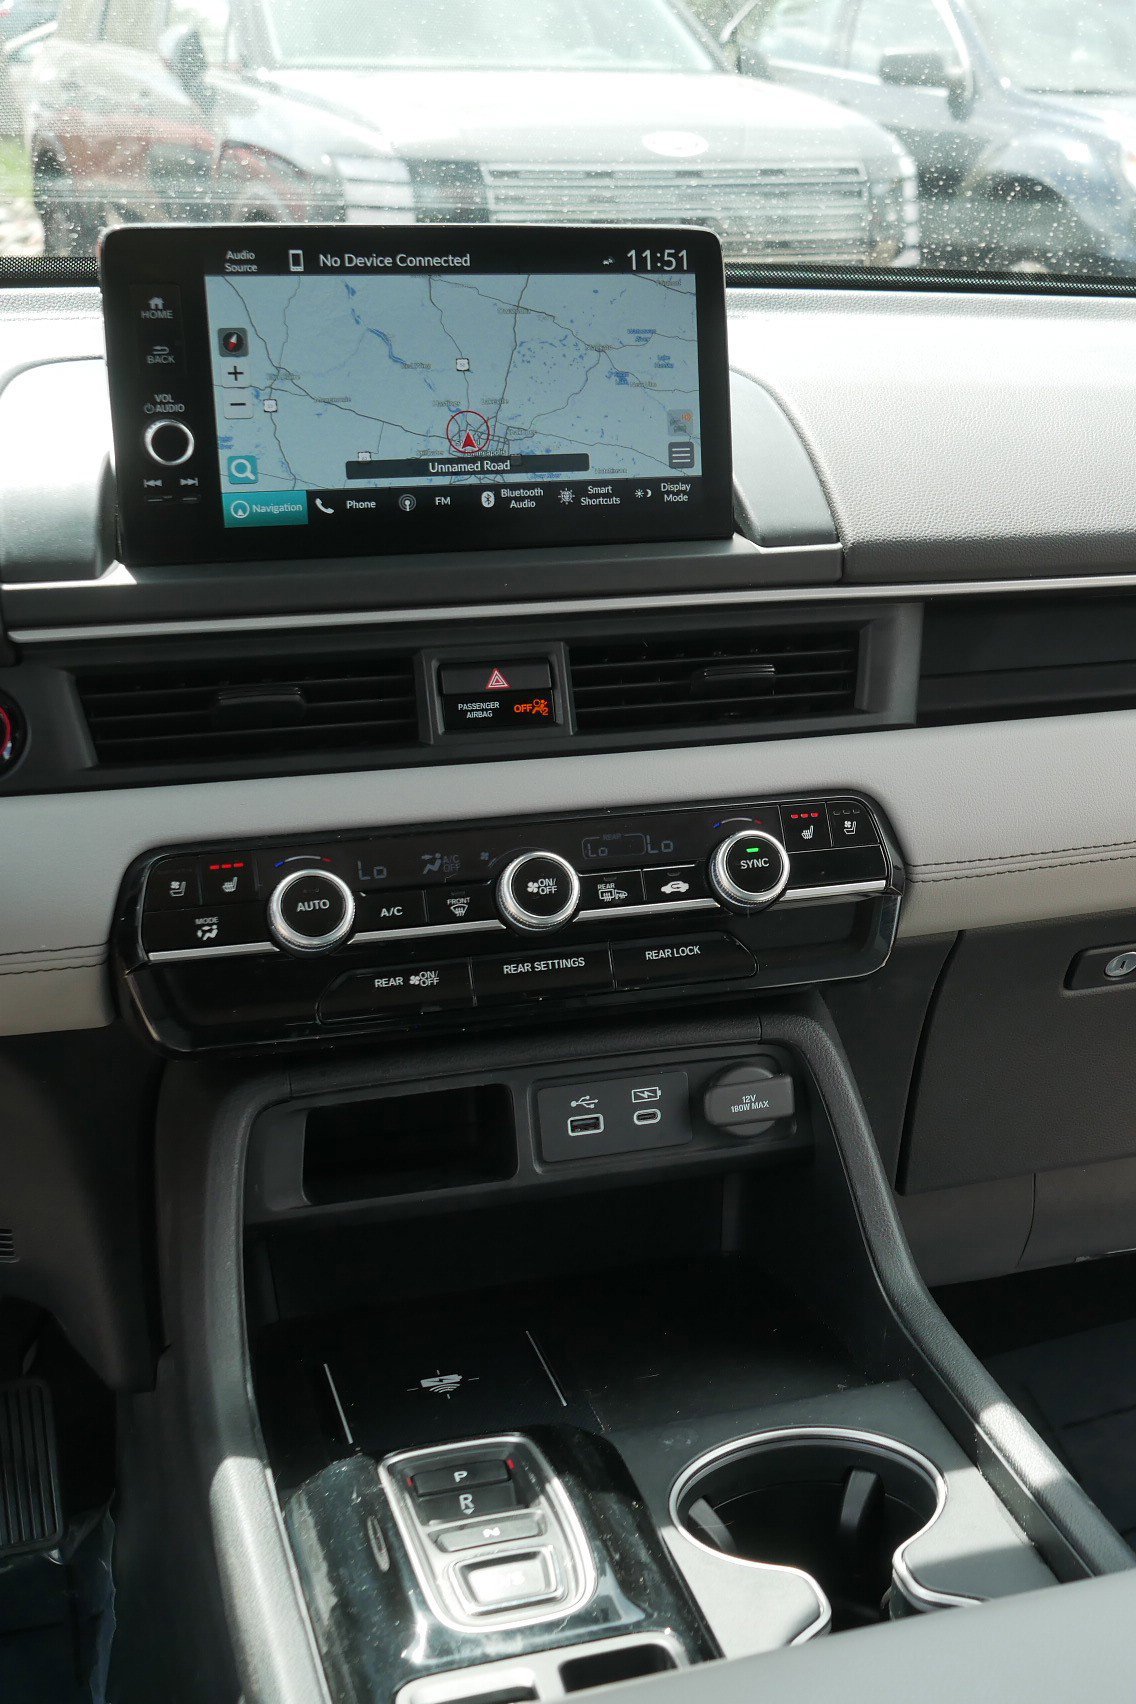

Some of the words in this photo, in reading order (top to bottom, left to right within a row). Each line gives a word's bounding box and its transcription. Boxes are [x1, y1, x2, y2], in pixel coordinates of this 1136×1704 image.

[226, 250, 256, 260] Audio
[319, 254, 341, 267] No
[344, 253, 393, 267] Device
[396, 253, 471, 267] Connected
[627, 249, 689, 271] 11:51
[224, 262, 258, 272] Source
[140, 310, 174, 319] HOME
[146, 355, 176, 364] BACK
[154, 393, 175, 403] VOL
[155, 403, 186, 413] AUDIO
[428, 461, 482, 473] Unnamed
[483, 460, 511, 471] Road
[501, 487, 544, 498] Bluetooth
[587, 485, 613, 495] Smart
[661, 482, 691, 495] Display
[435, 496, 451, 506] FM
[580, 495, 621, 506] Shortcuts
[664, 492, 689, 503] Mode
[252, 502, 303, 514] Navigation
[346, 499, 376, 509] Phone
[509, 498, 537, 509] Audio
[457, 701, 500, 711] PASSENGER
[513, 703, 533, 713] OFF
[466, 710, 493, 719] AIRBAG
[646, 834, 674, 854] Lo
[740, 856, 770, 870] SYNC
[357, 860, 388, 882] Lo
[538, 877, 557, 887] ON/
[597, 882, 616, 890] REAR
[539, 885, 558, 896] OFF
[296, 899, 330, 913] AUTO
[446, 896, 471, 906] FRONT
[380, 905, 403, 918] A/C
[195, 915, 220, 926] MODE
[645, 948, 672, 961] REAR
[673, 945, 701, 958] LOCK
[503, 962, 532, 975] REAR
[533, 957, 586, 972] SETTINGS
[419, 970, 439, 980] ON/
[374, 976, 404, 988] REAR
[420, 977, 440, 987] OFF
[742, 1094, 757, 1103] 12V
[731, 1104, 750, 1113] 180W
[752, 1101, 769, 1110] MAX
[453, 1470, 468, 1483] P
[458, 1493, 475, 1511] R
